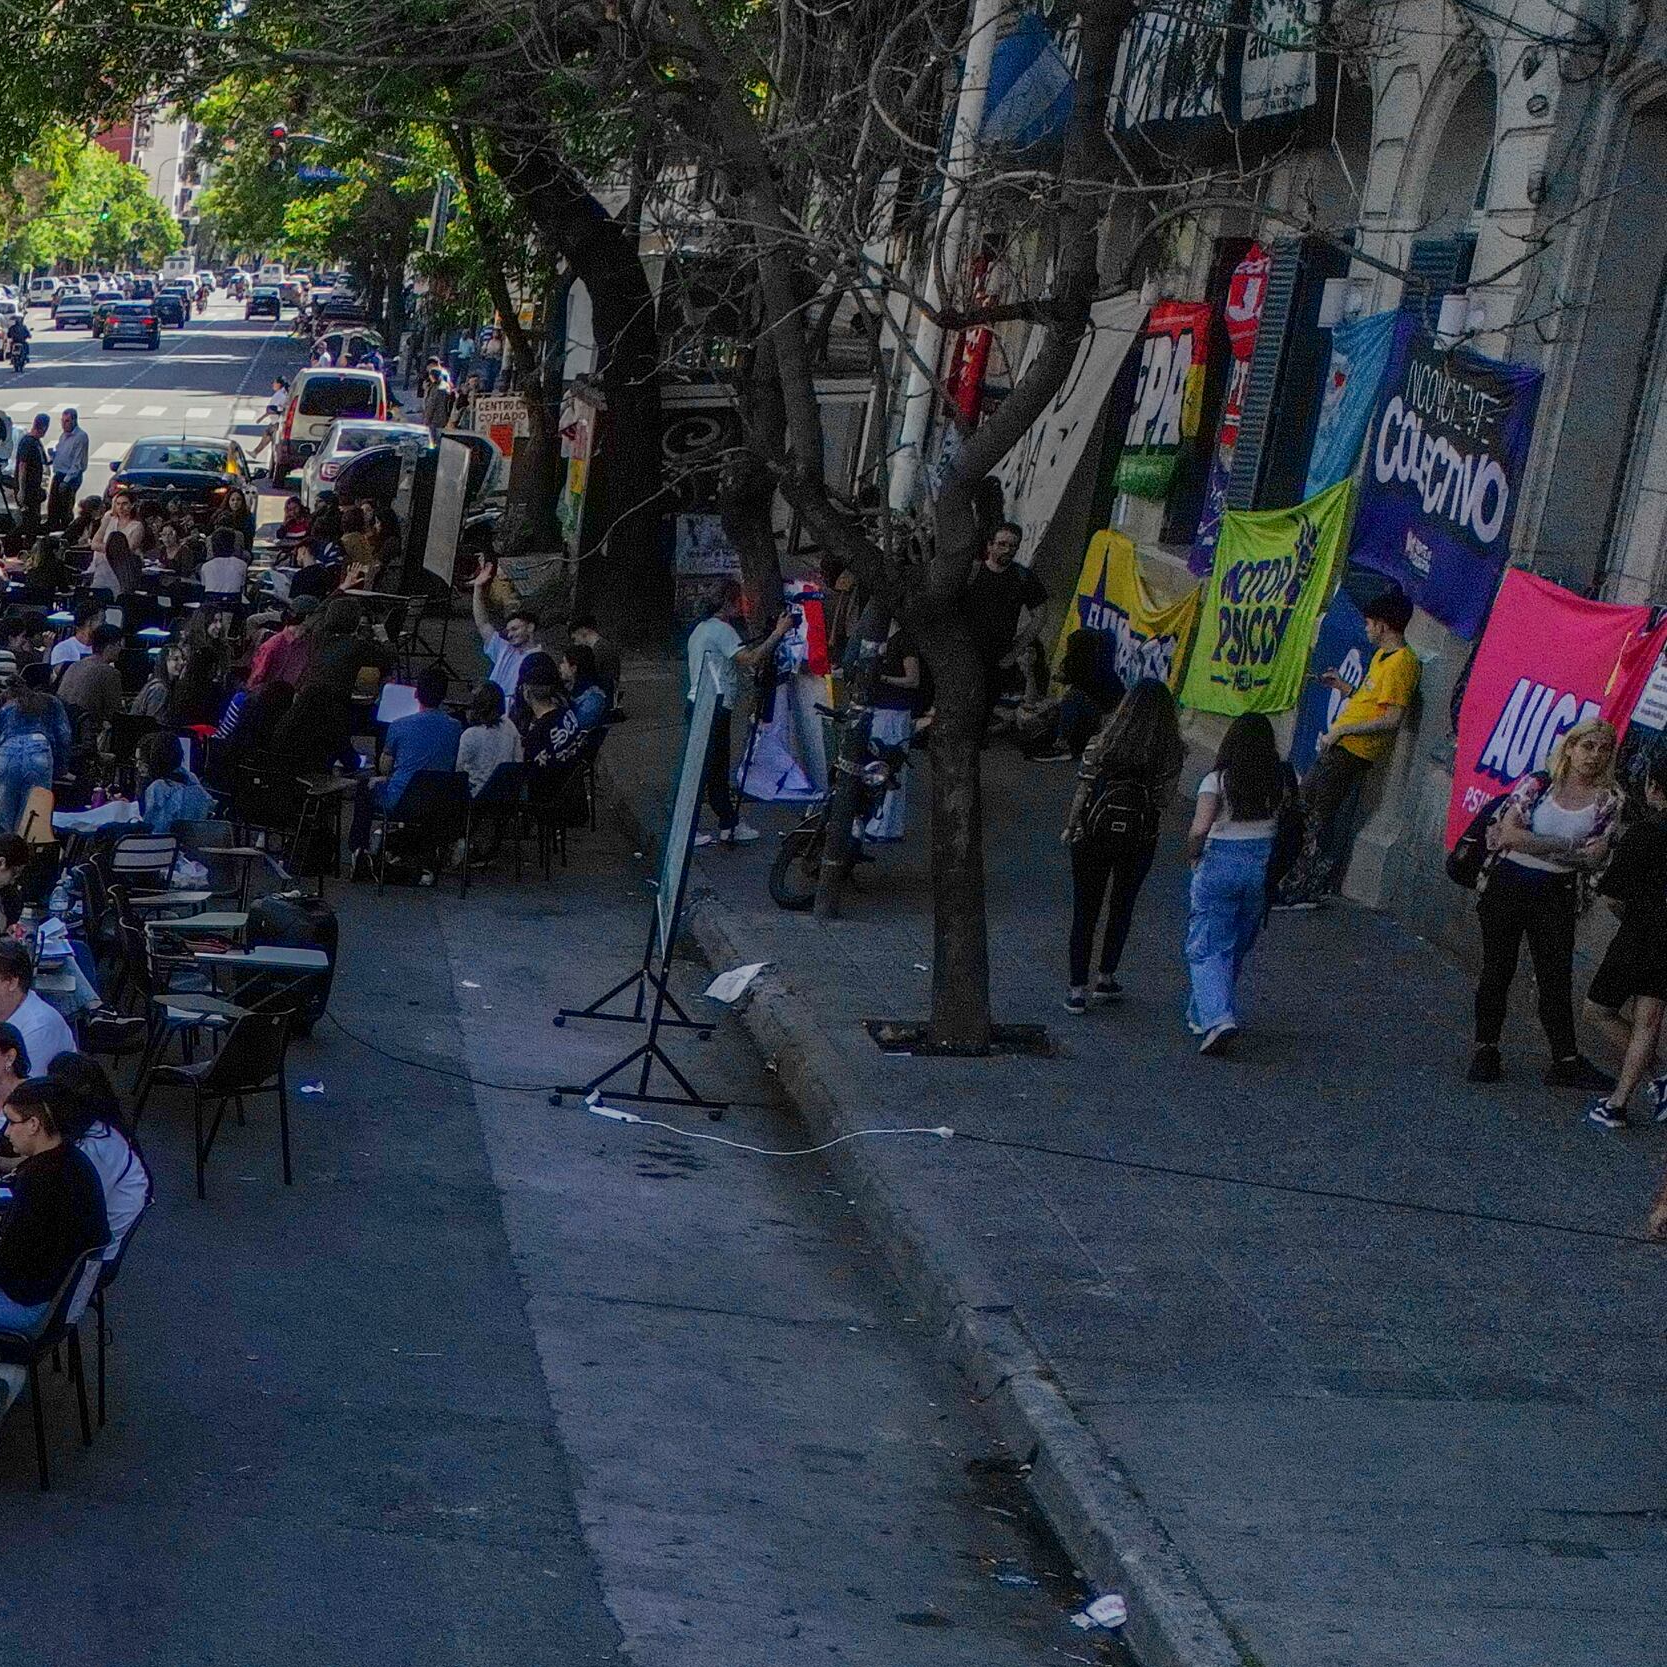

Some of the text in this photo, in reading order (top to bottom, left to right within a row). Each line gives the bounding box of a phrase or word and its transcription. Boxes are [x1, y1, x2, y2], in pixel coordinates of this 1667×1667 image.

[478, 400, 514, 411] CENTRO
[478, 411, 527, 422] COPIADO
[1375, 395, 1509, 543] COLECTIVO
